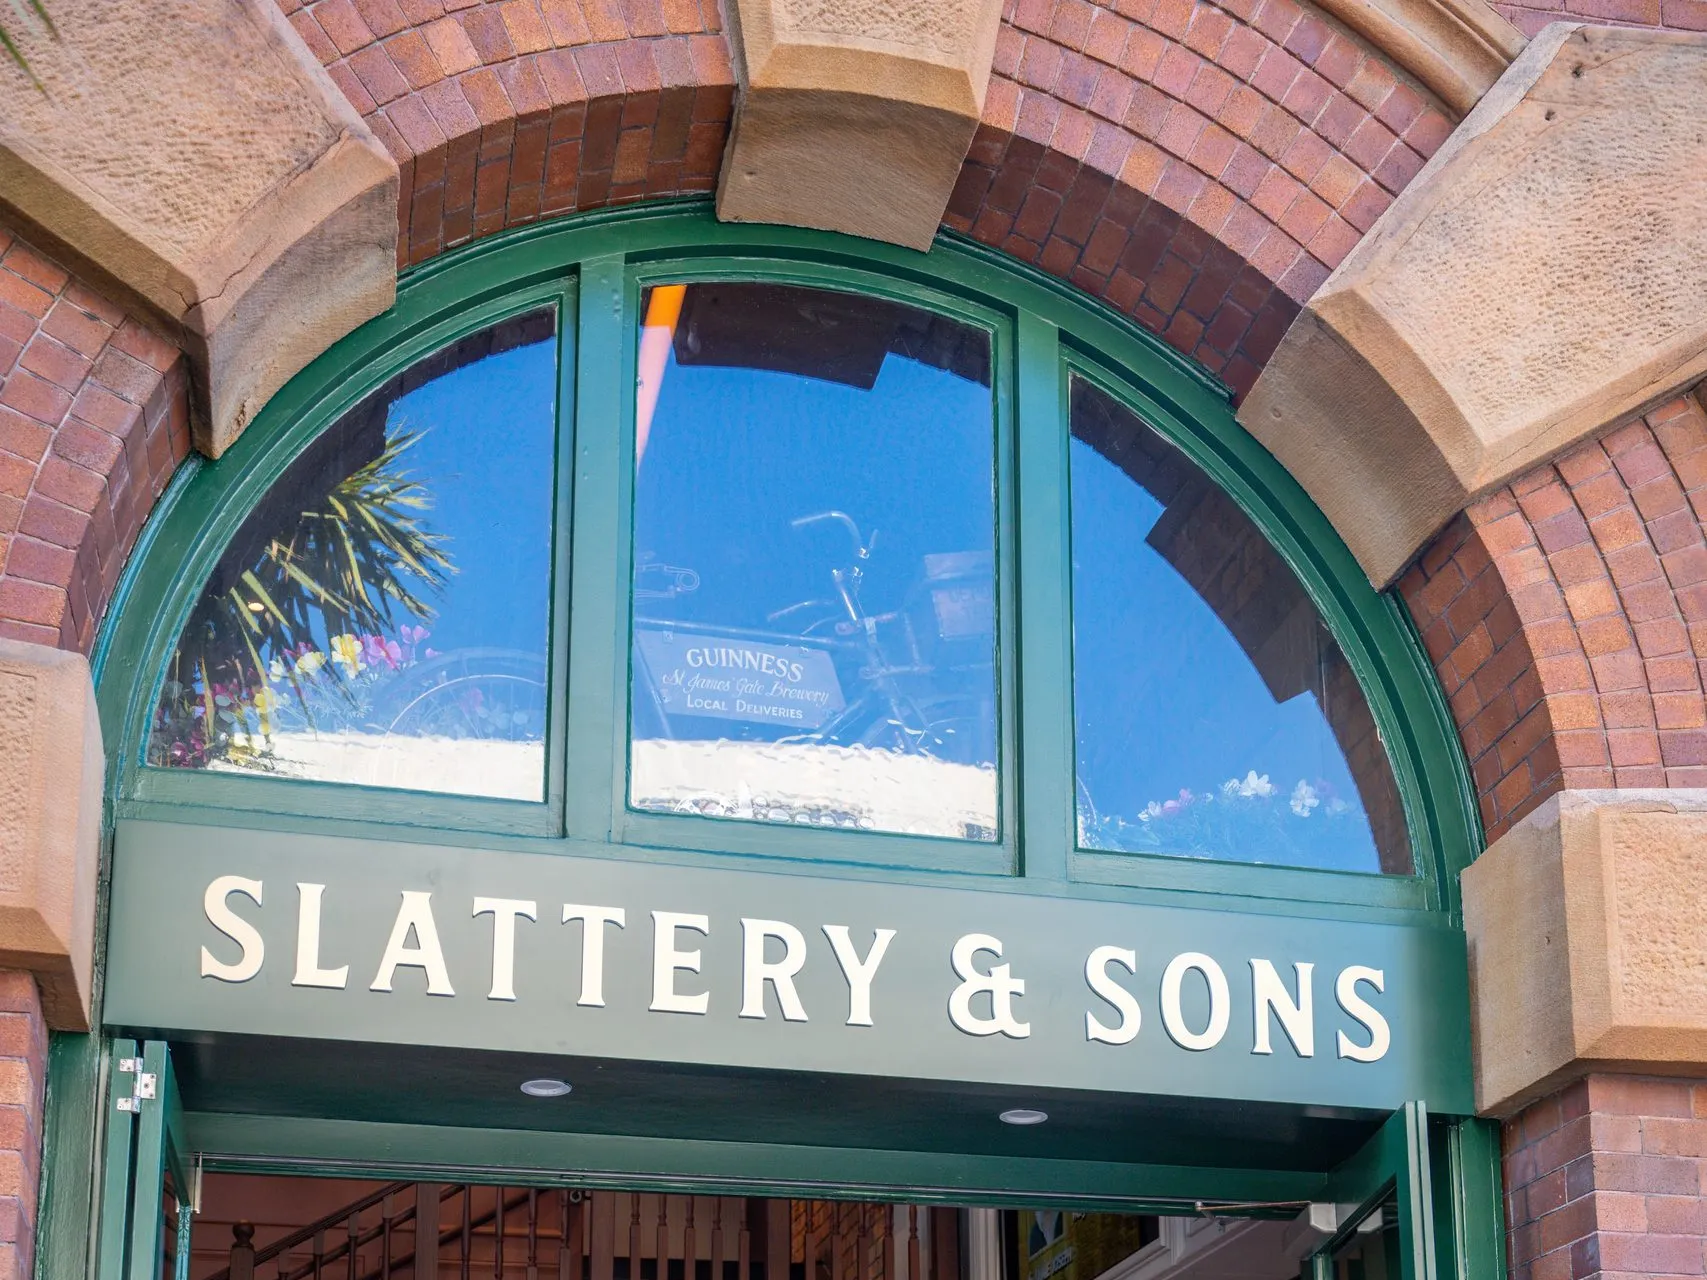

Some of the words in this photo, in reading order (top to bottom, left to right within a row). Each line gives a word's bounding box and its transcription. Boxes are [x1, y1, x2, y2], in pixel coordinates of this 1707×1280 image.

[686, 648, 804, 683] GUINNESS
[662, 668, 686, 687] St
[732, 677, 765, 698] Gate
[765, 680, 830, 706] Brewery
[687, 694, 728, 711] LOCAL
[736, 700, 804, 719] DELIVERIES
[200, 875, 897, 1027] SLATTERY
[948, 933, 1031, 1039] &
[1084, 945, 1391, 1063] SONS
